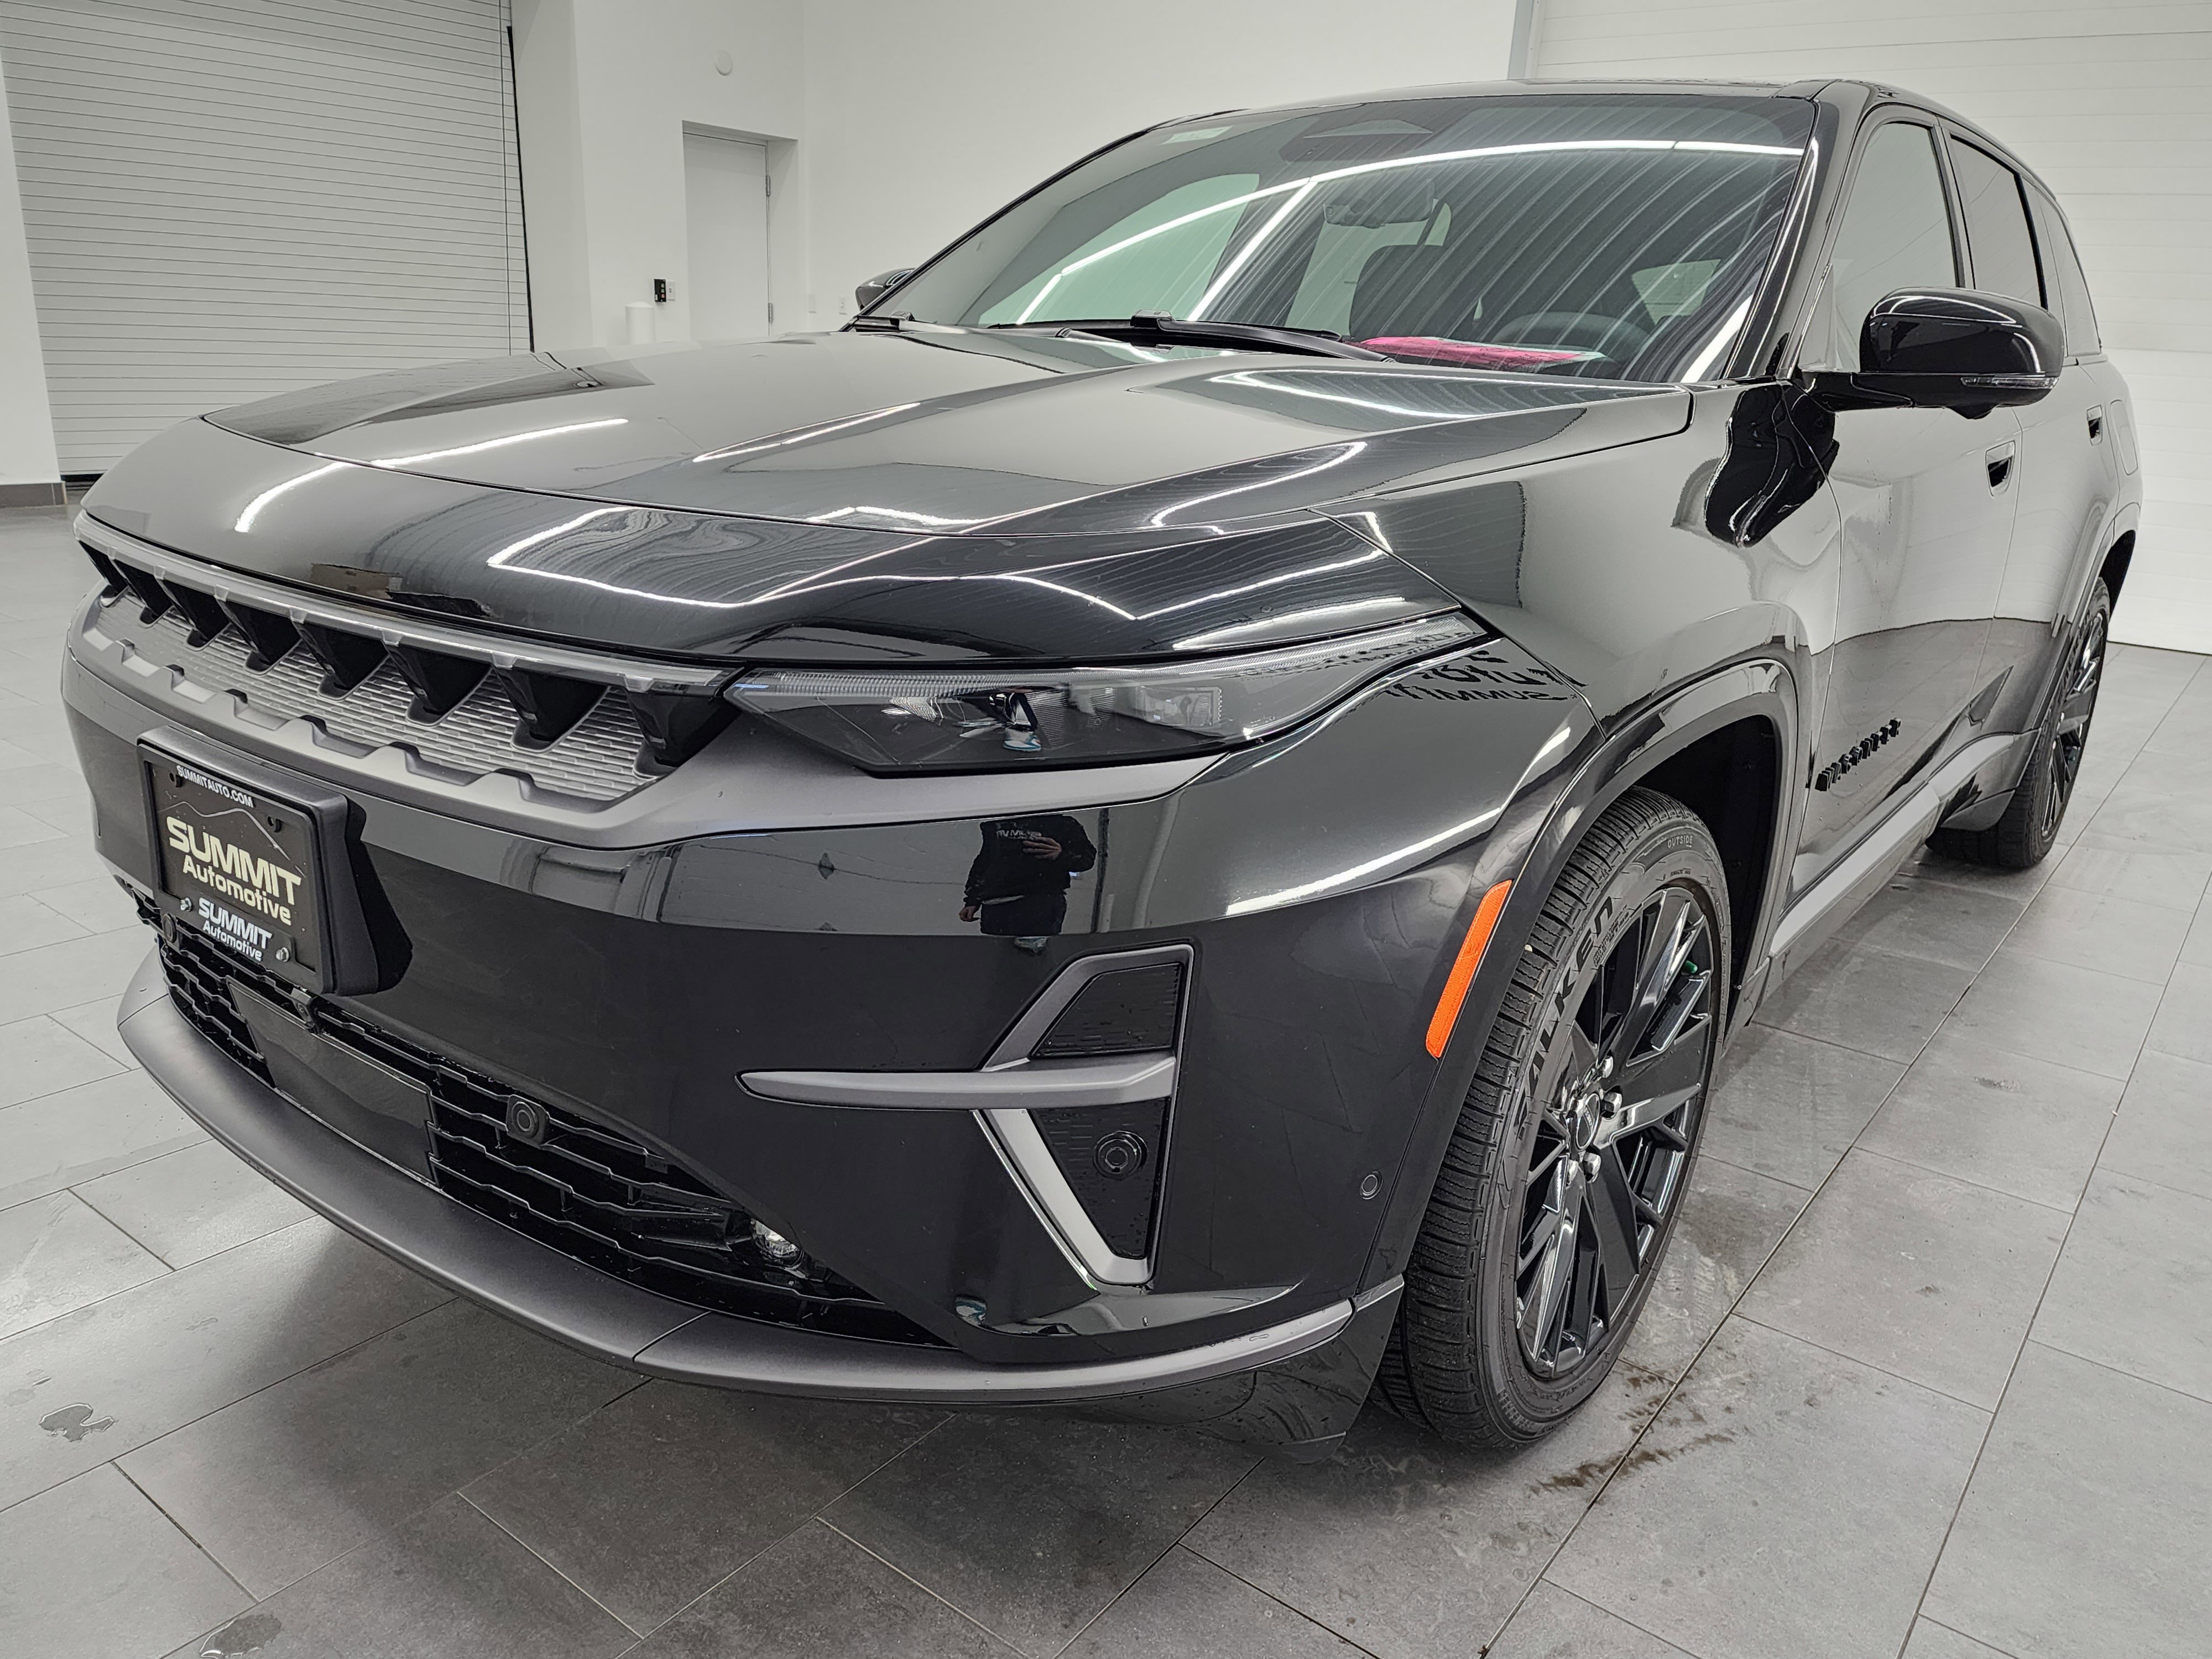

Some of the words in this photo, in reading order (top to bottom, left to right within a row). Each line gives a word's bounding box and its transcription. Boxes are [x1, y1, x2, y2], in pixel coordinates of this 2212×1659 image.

[176, 765, 254, 808] SUMMITAUTO.COM
[166, 816, 302, 905] SUMMIT
[1667, 835, 1693, 848] OUTSIDE
[182, 855, 292, 925] Automotive
[199, 896, 273, 950] SUMMIT
[202, 921, 262, 962] Automotive
